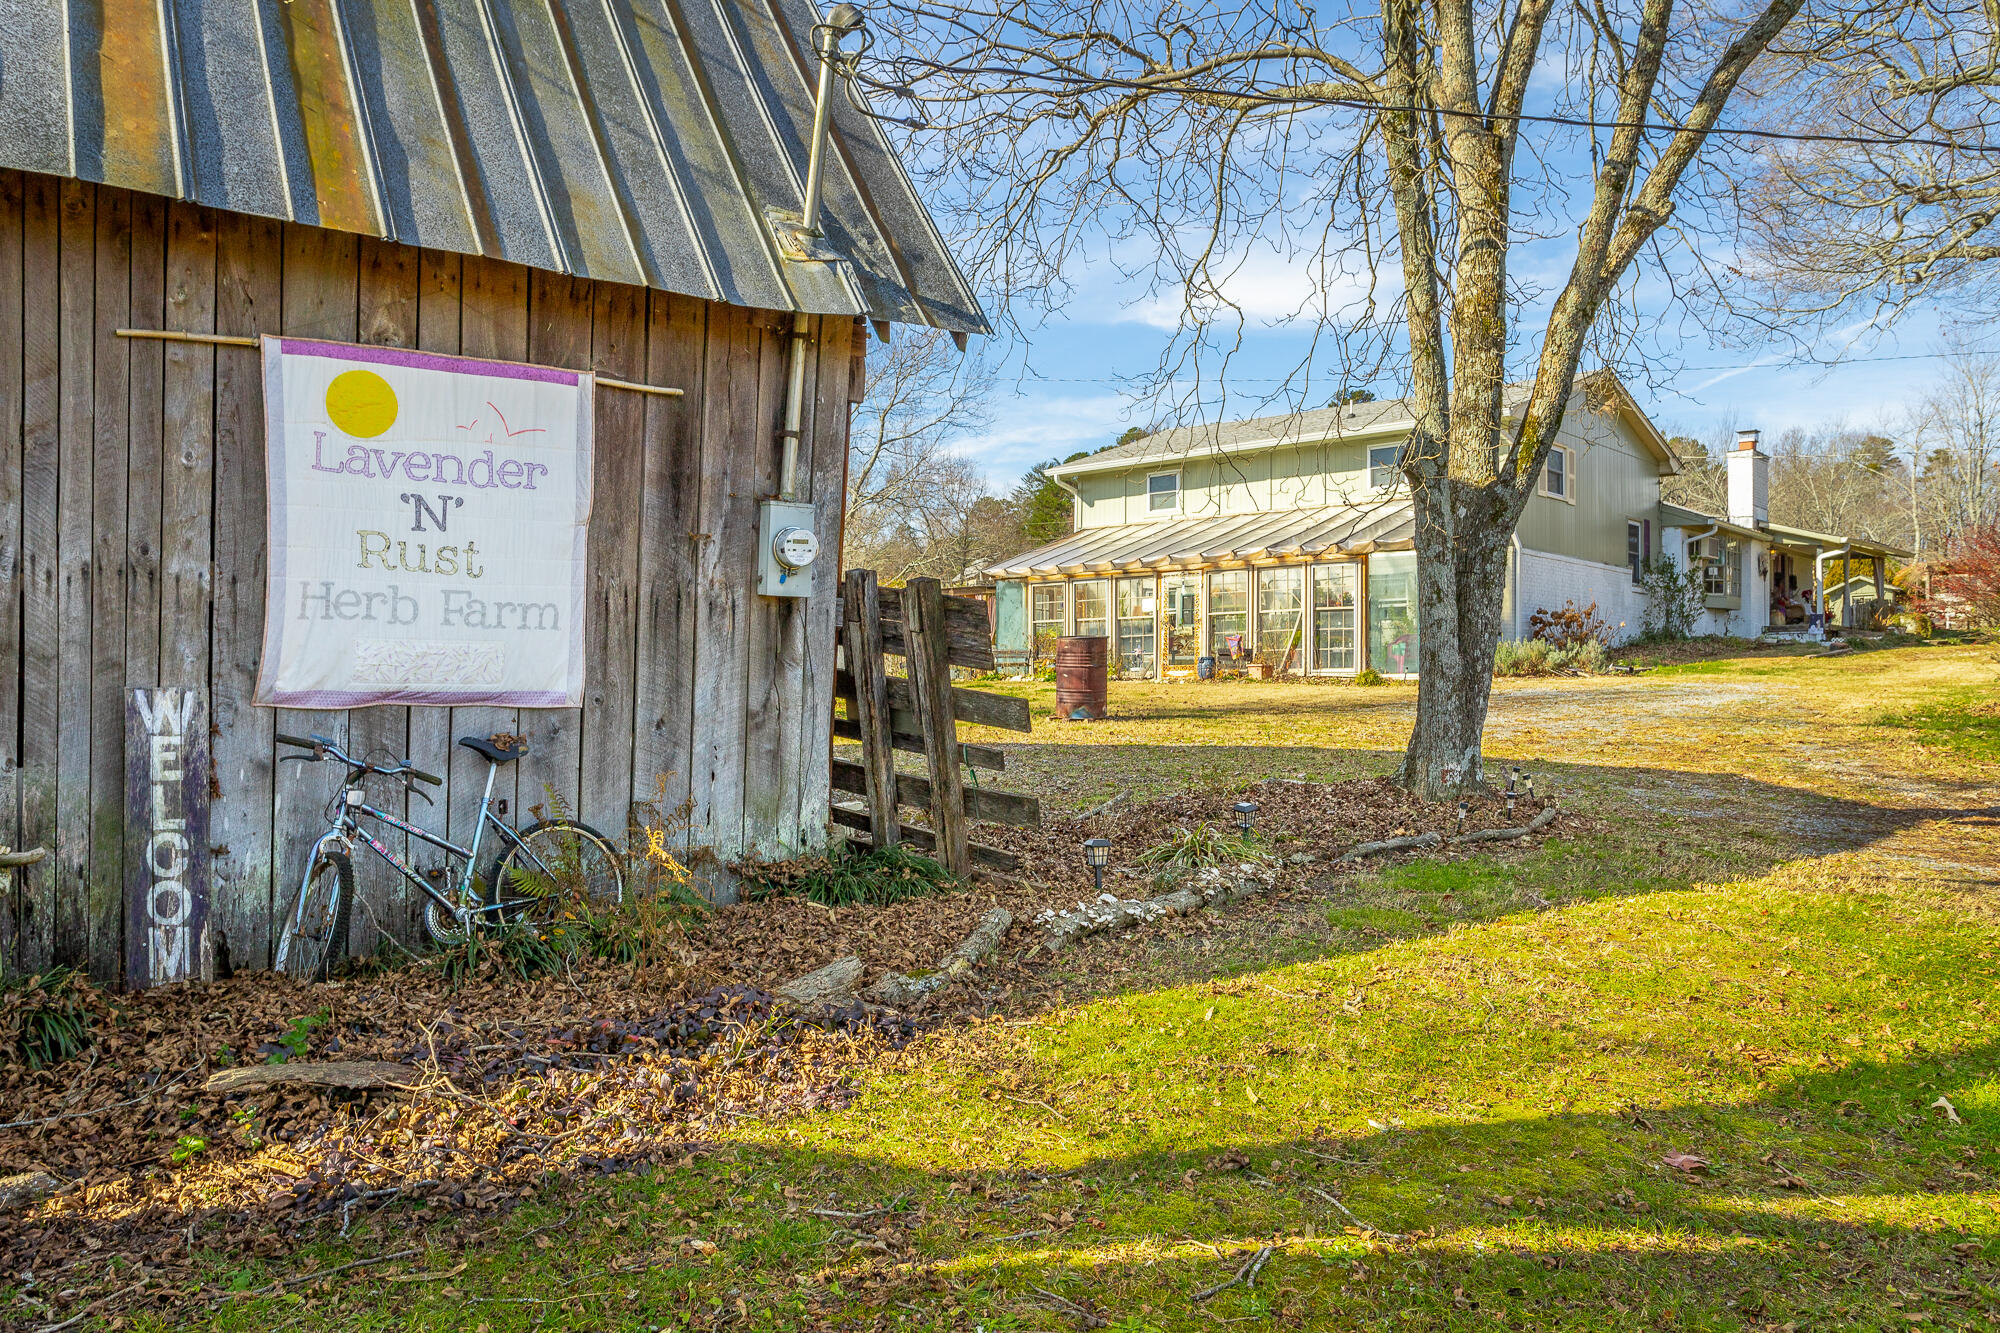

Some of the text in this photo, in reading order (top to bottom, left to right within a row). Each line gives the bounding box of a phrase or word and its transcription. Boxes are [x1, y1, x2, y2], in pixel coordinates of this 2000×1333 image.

[311, 431, 549, 490] Lavender
[356, 530, 484, 579] Rust
[296, 581, 562, 632] Herb Farm
[133, 688, 194, 986] WELCOM
